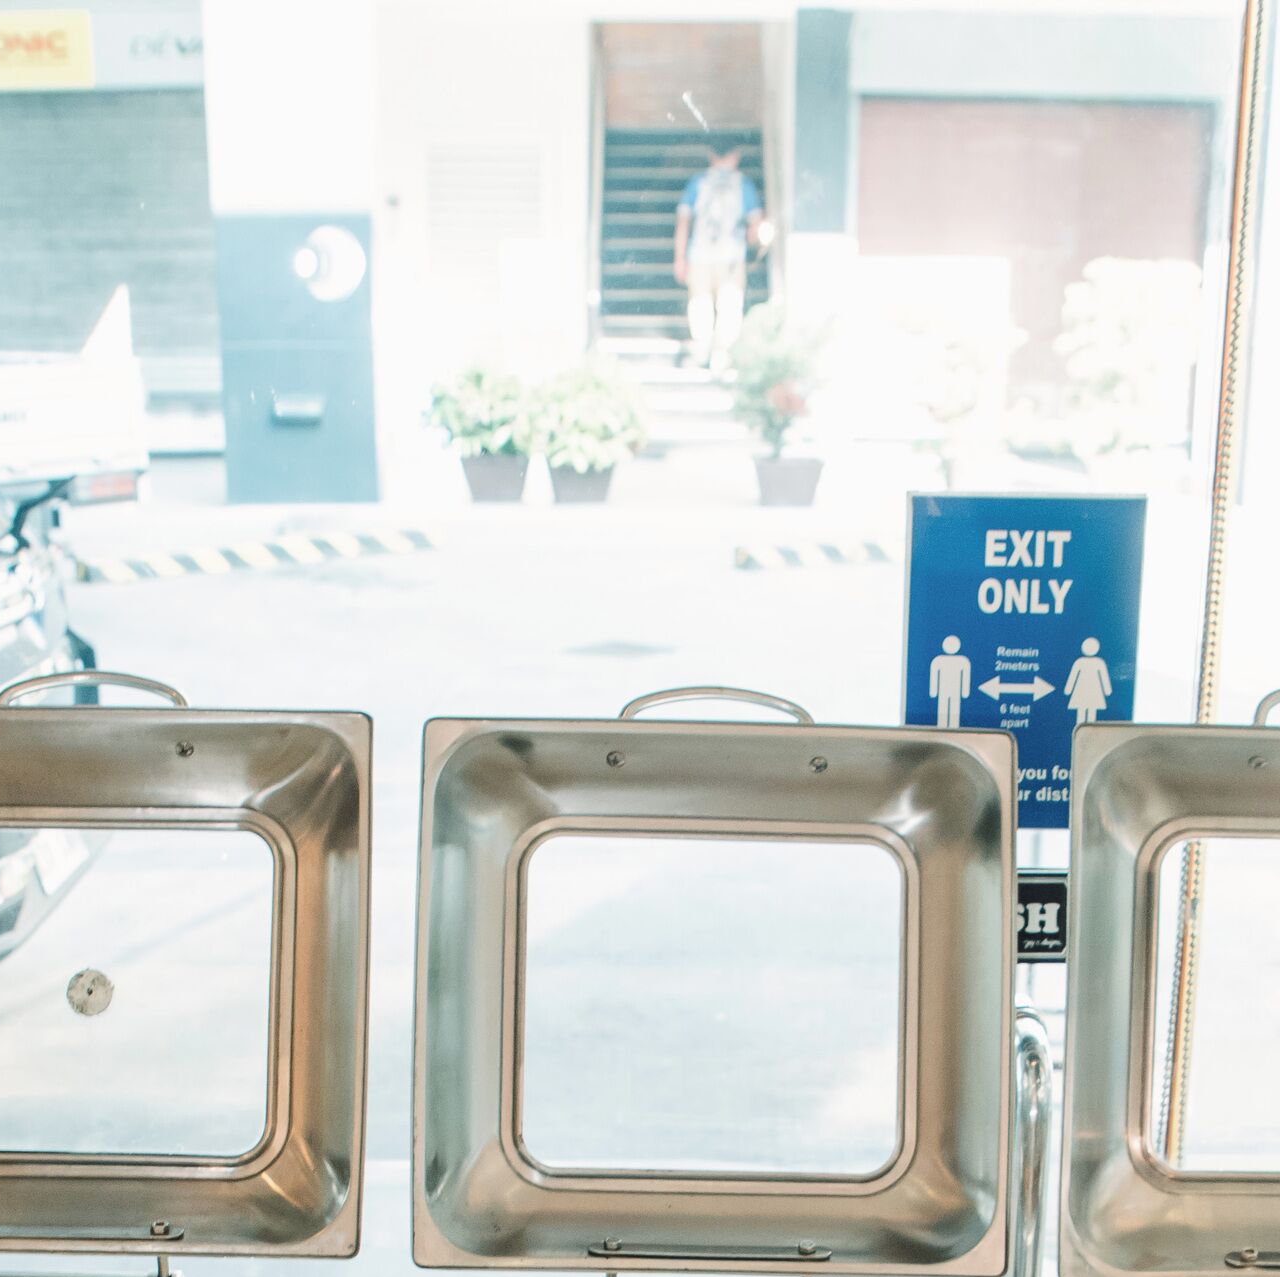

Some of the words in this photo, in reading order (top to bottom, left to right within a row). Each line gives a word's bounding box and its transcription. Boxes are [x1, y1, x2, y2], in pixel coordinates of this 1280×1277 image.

[984, 529, 1072, 568] EXIT
[977, 577, 1073, 614] ONLY
[996, 646, 1039, 657] Remain
[995, 660, 1040, 672] 2meters
[999, 703, 1007, 715] 6
[1009, 703, 1031, 715] feet
[1000, 717, 1029, 729] apart
[1017, 768, 1048, 784] you
[1052, 764, 1070, 780] fo
[1036, 786, 1069, 801] dist
